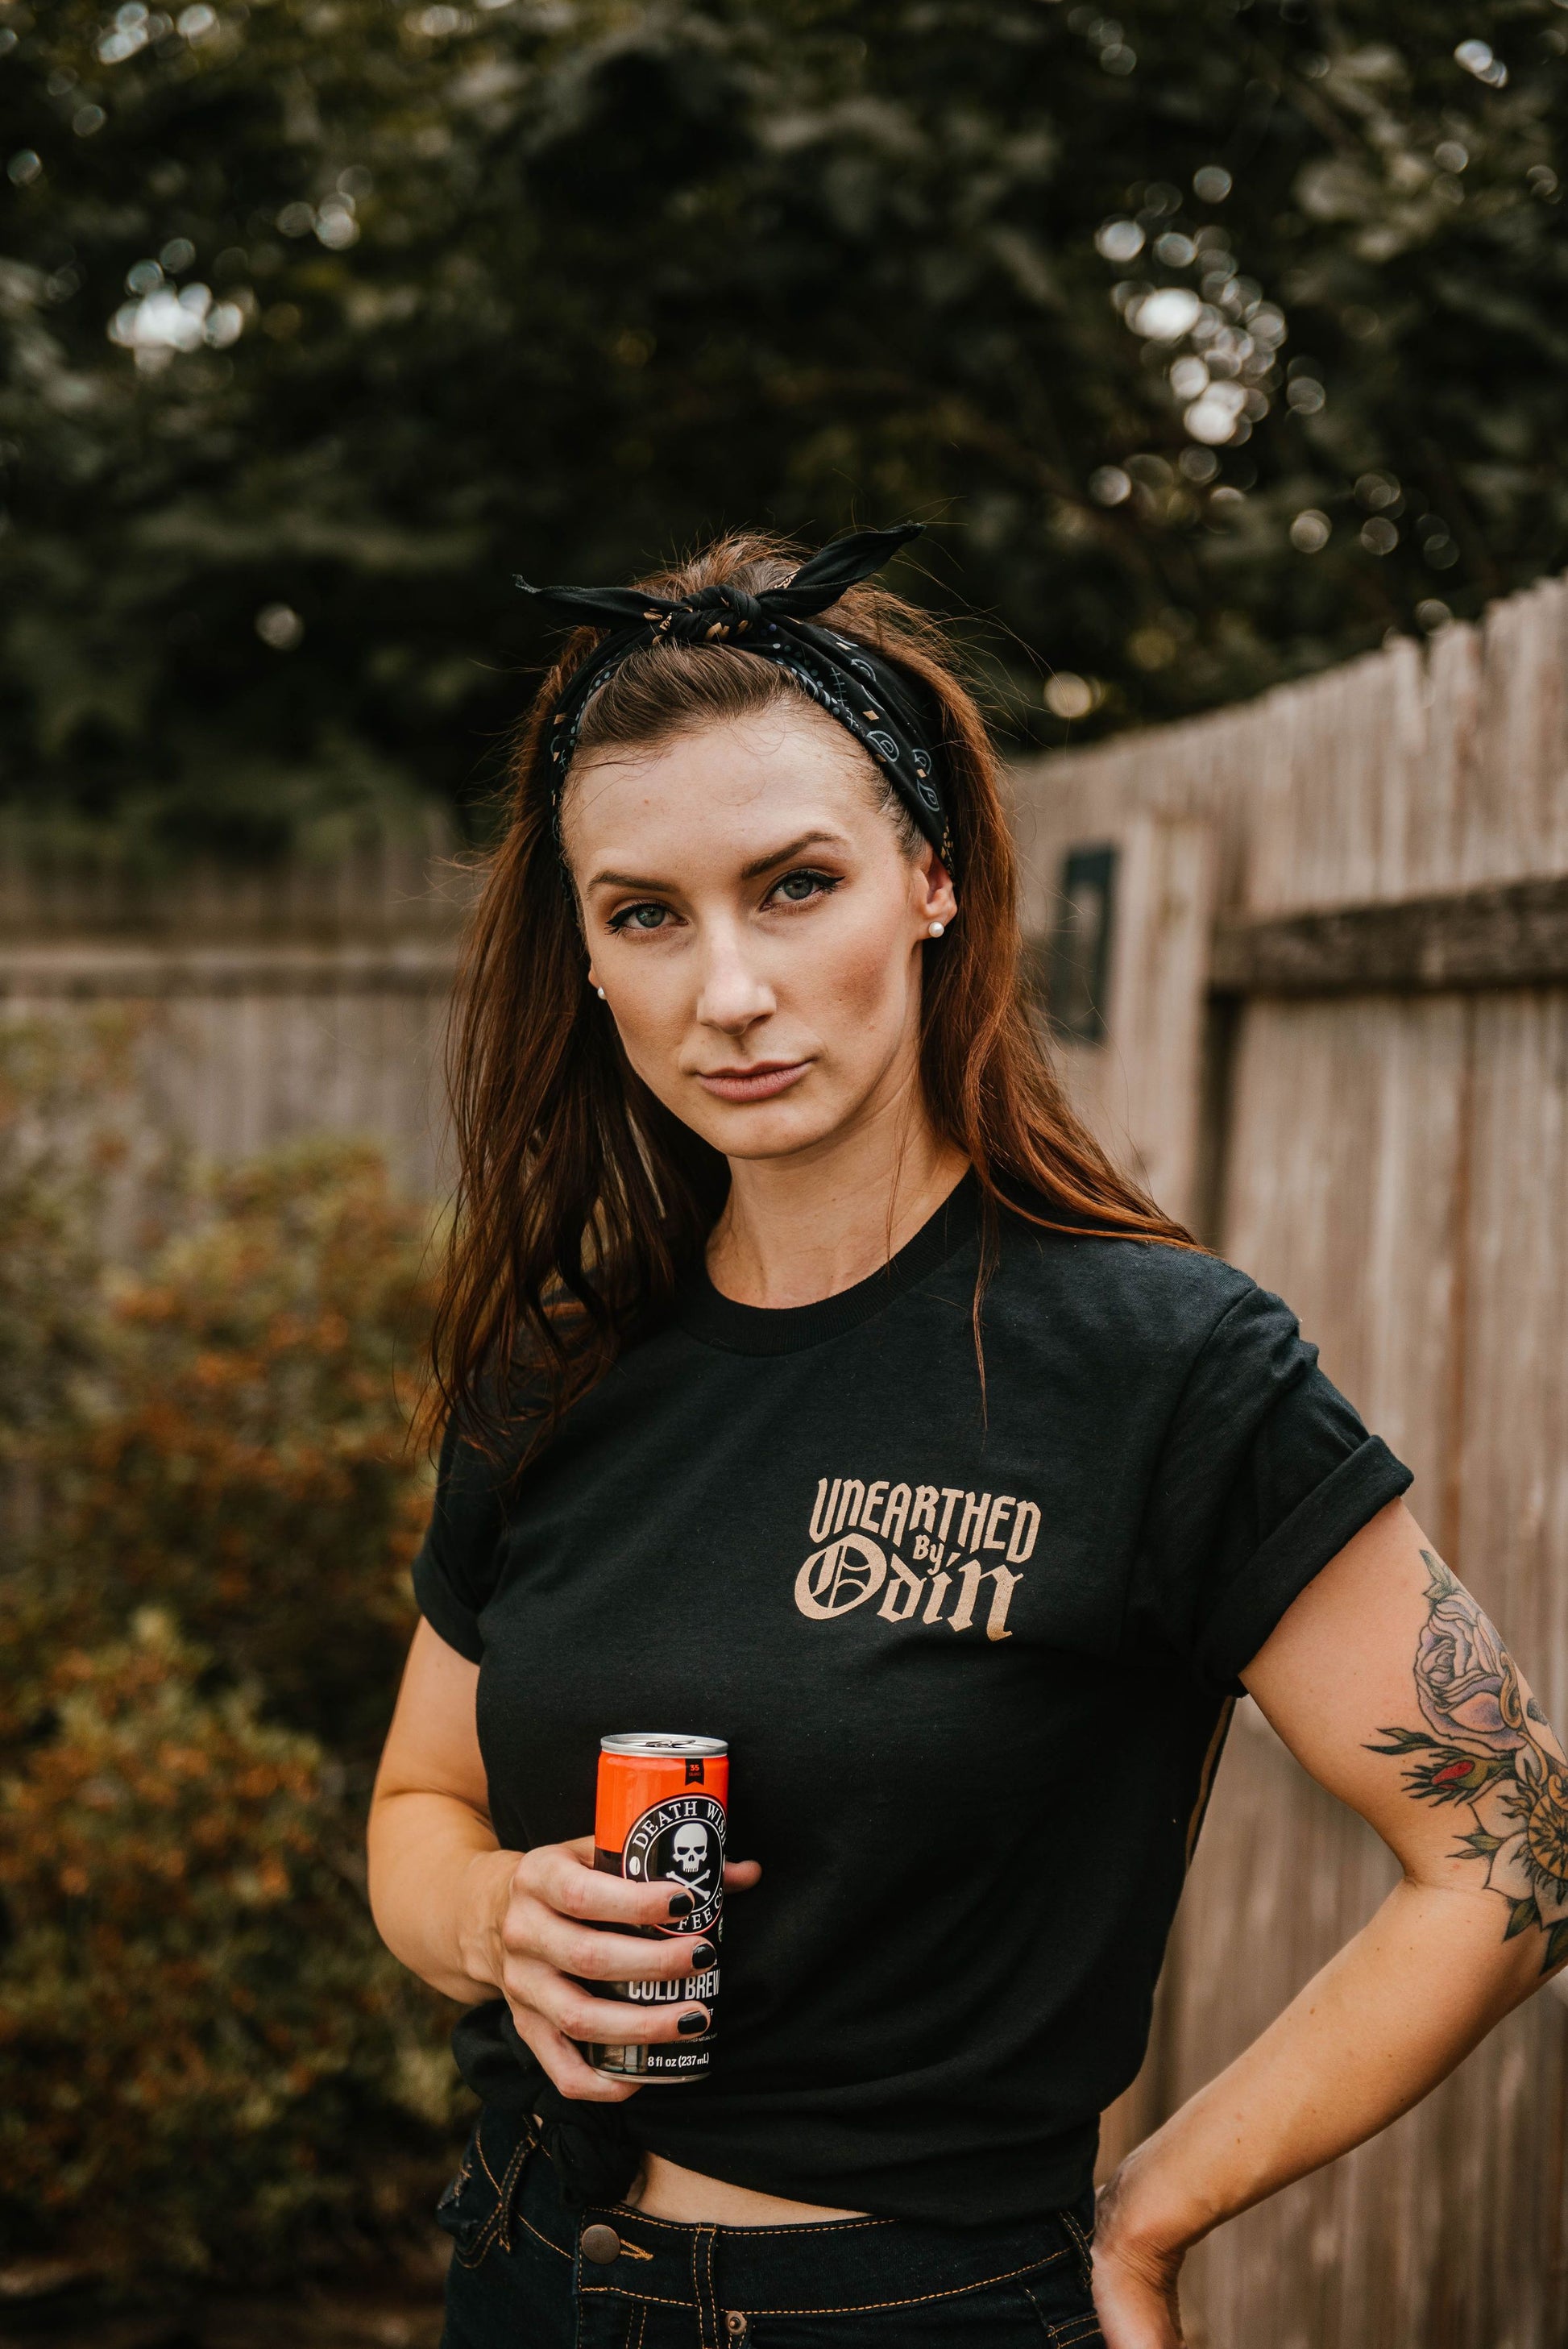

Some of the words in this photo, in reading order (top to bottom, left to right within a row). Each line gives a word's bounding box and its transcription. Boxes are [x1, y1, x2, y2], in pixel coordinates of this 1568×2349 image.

[809, 1478, 1042, 1563] UNEARTHED
[794, 1533, 1024, 1641] Odin
[633, 1801, 698, 1850] DEATH
[628, 1980, 679, 2000] COLD
[685, 1969, 720, 1999] BREW
[647, 2056, 654, 2067] 8
[656, 2056, 663, 2067] fl
[666, 2058, 677, 2067] oz
